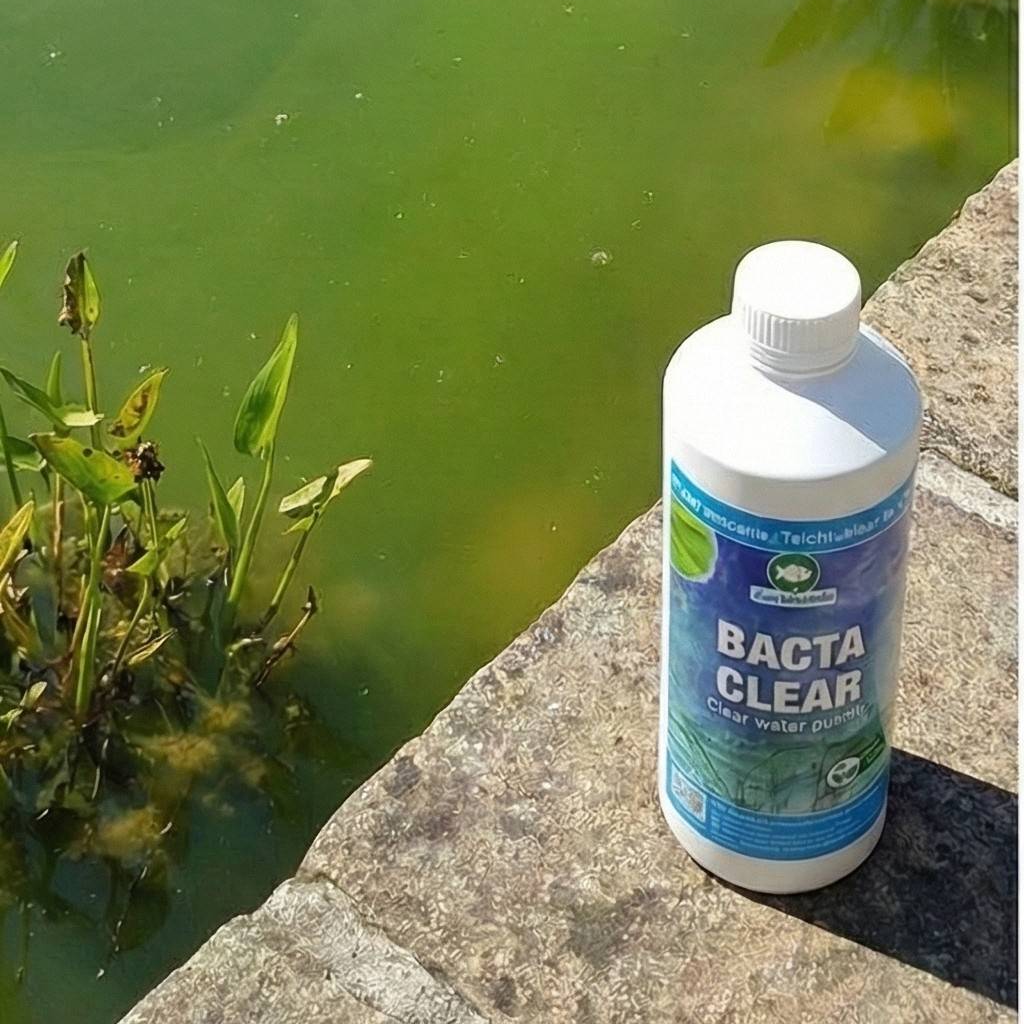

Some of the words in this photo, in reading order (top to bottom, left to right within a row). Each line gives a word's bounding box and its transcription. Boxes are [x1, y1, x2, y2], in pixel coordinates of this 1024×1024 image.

[717, 618, 866, 671] BACTA
[716, 665, 863, 714] CLEAR
[706, 696, 750, 726] Clear
[754, 716, 807, 734] water
